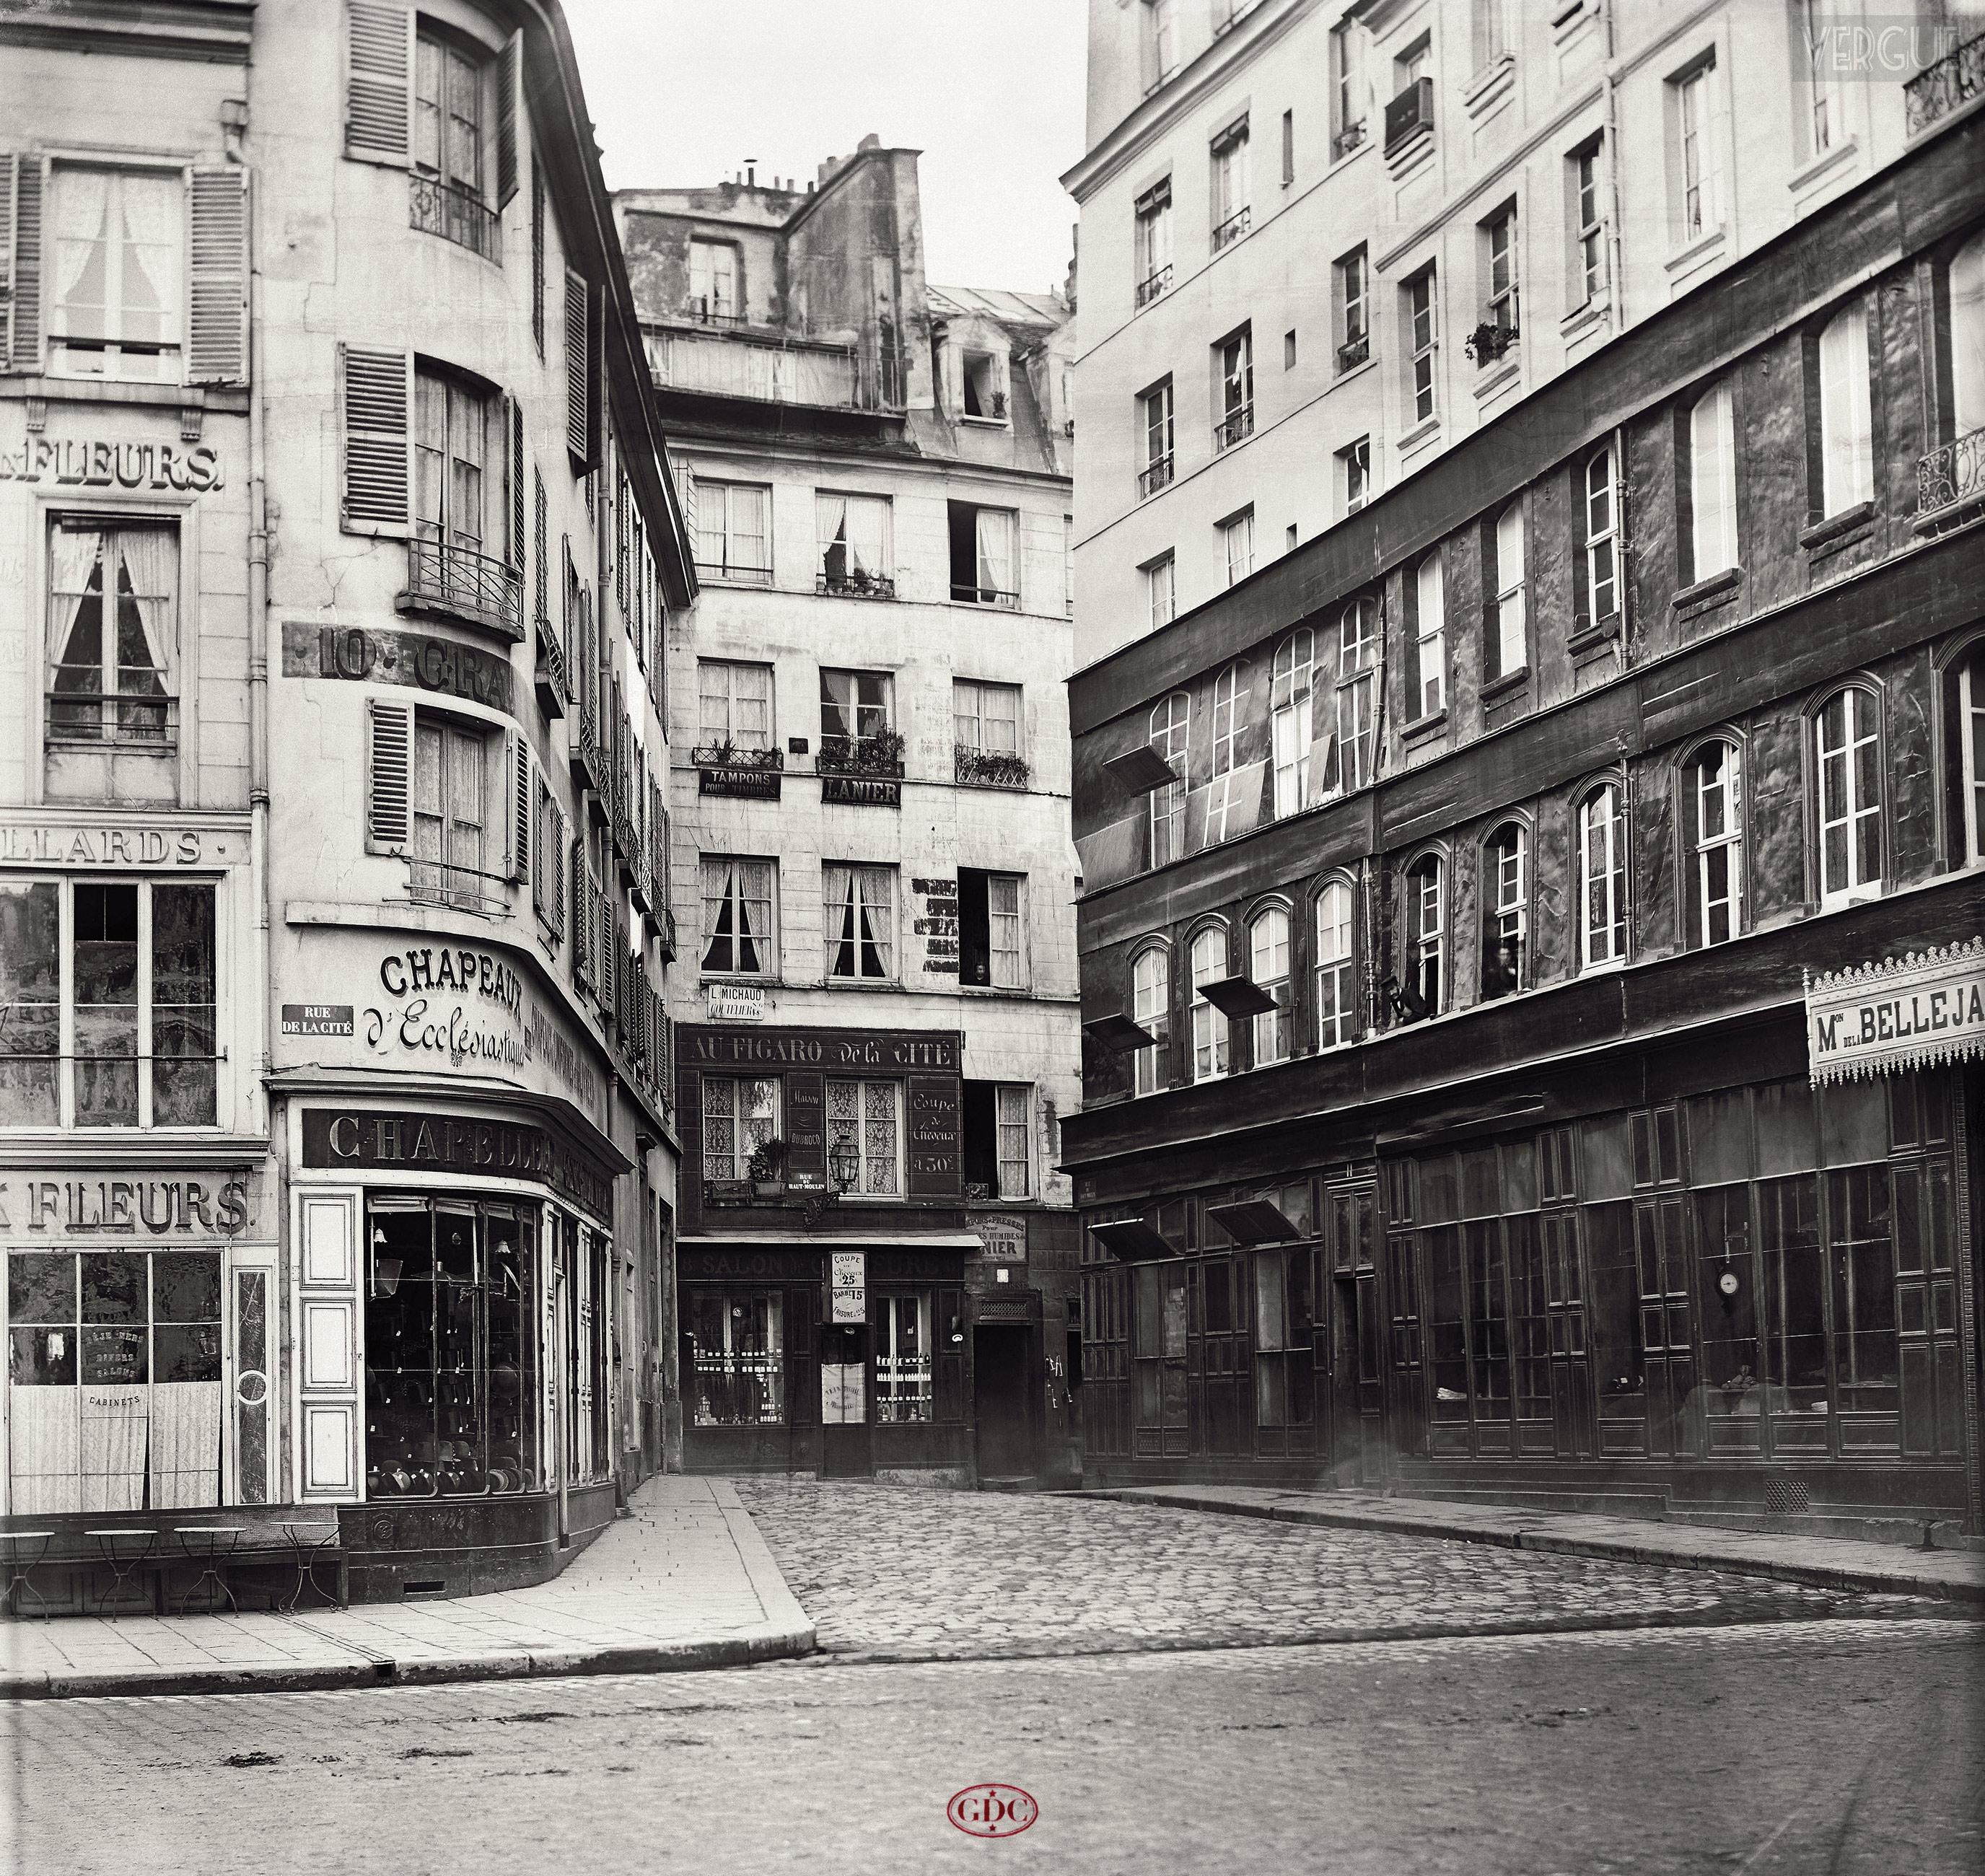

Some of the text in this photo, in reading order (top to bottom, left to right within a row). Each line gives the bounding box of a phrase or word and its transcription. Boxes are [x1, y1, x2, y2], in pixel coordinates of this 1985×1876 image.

[711, 771, 771, 786] TAMPONS
[705, 783, 726, 793] POUR
[826, 778, 899, 802] LANIER
[1, 828, 201, 865] LLARDS
[380, 948, 522, 1023] CHAPEAUX
[722, 988, 761, 1001] MICHAUD
[304, 1007, 330, 1018] RUE
[1860, 990, 1948, 1045] BELLE
[282, 1021, 352, 1033] DE LA CITÉ
[691, 1037, 723, 1060] AU
[731, 1037, 823, 1062] FIGARO
[893, 1040, 950, 1065] CITÉ
[913, 1093, 955, 1113] Coupe
[991, 1216, 1025, 1232] PRESSES
[978, 1241, 1017, 1254] NIER
[702, 1253, 783, 1274] SALON
[842, 1275, 855, 1285] 25
[851, 1290, 862, 1300] 15
[833, 1306, 854, 1318] FRISURE
[97, 1367, 137, 1378] SALONS
[89, 1395, 140, 1406] CABINETS
